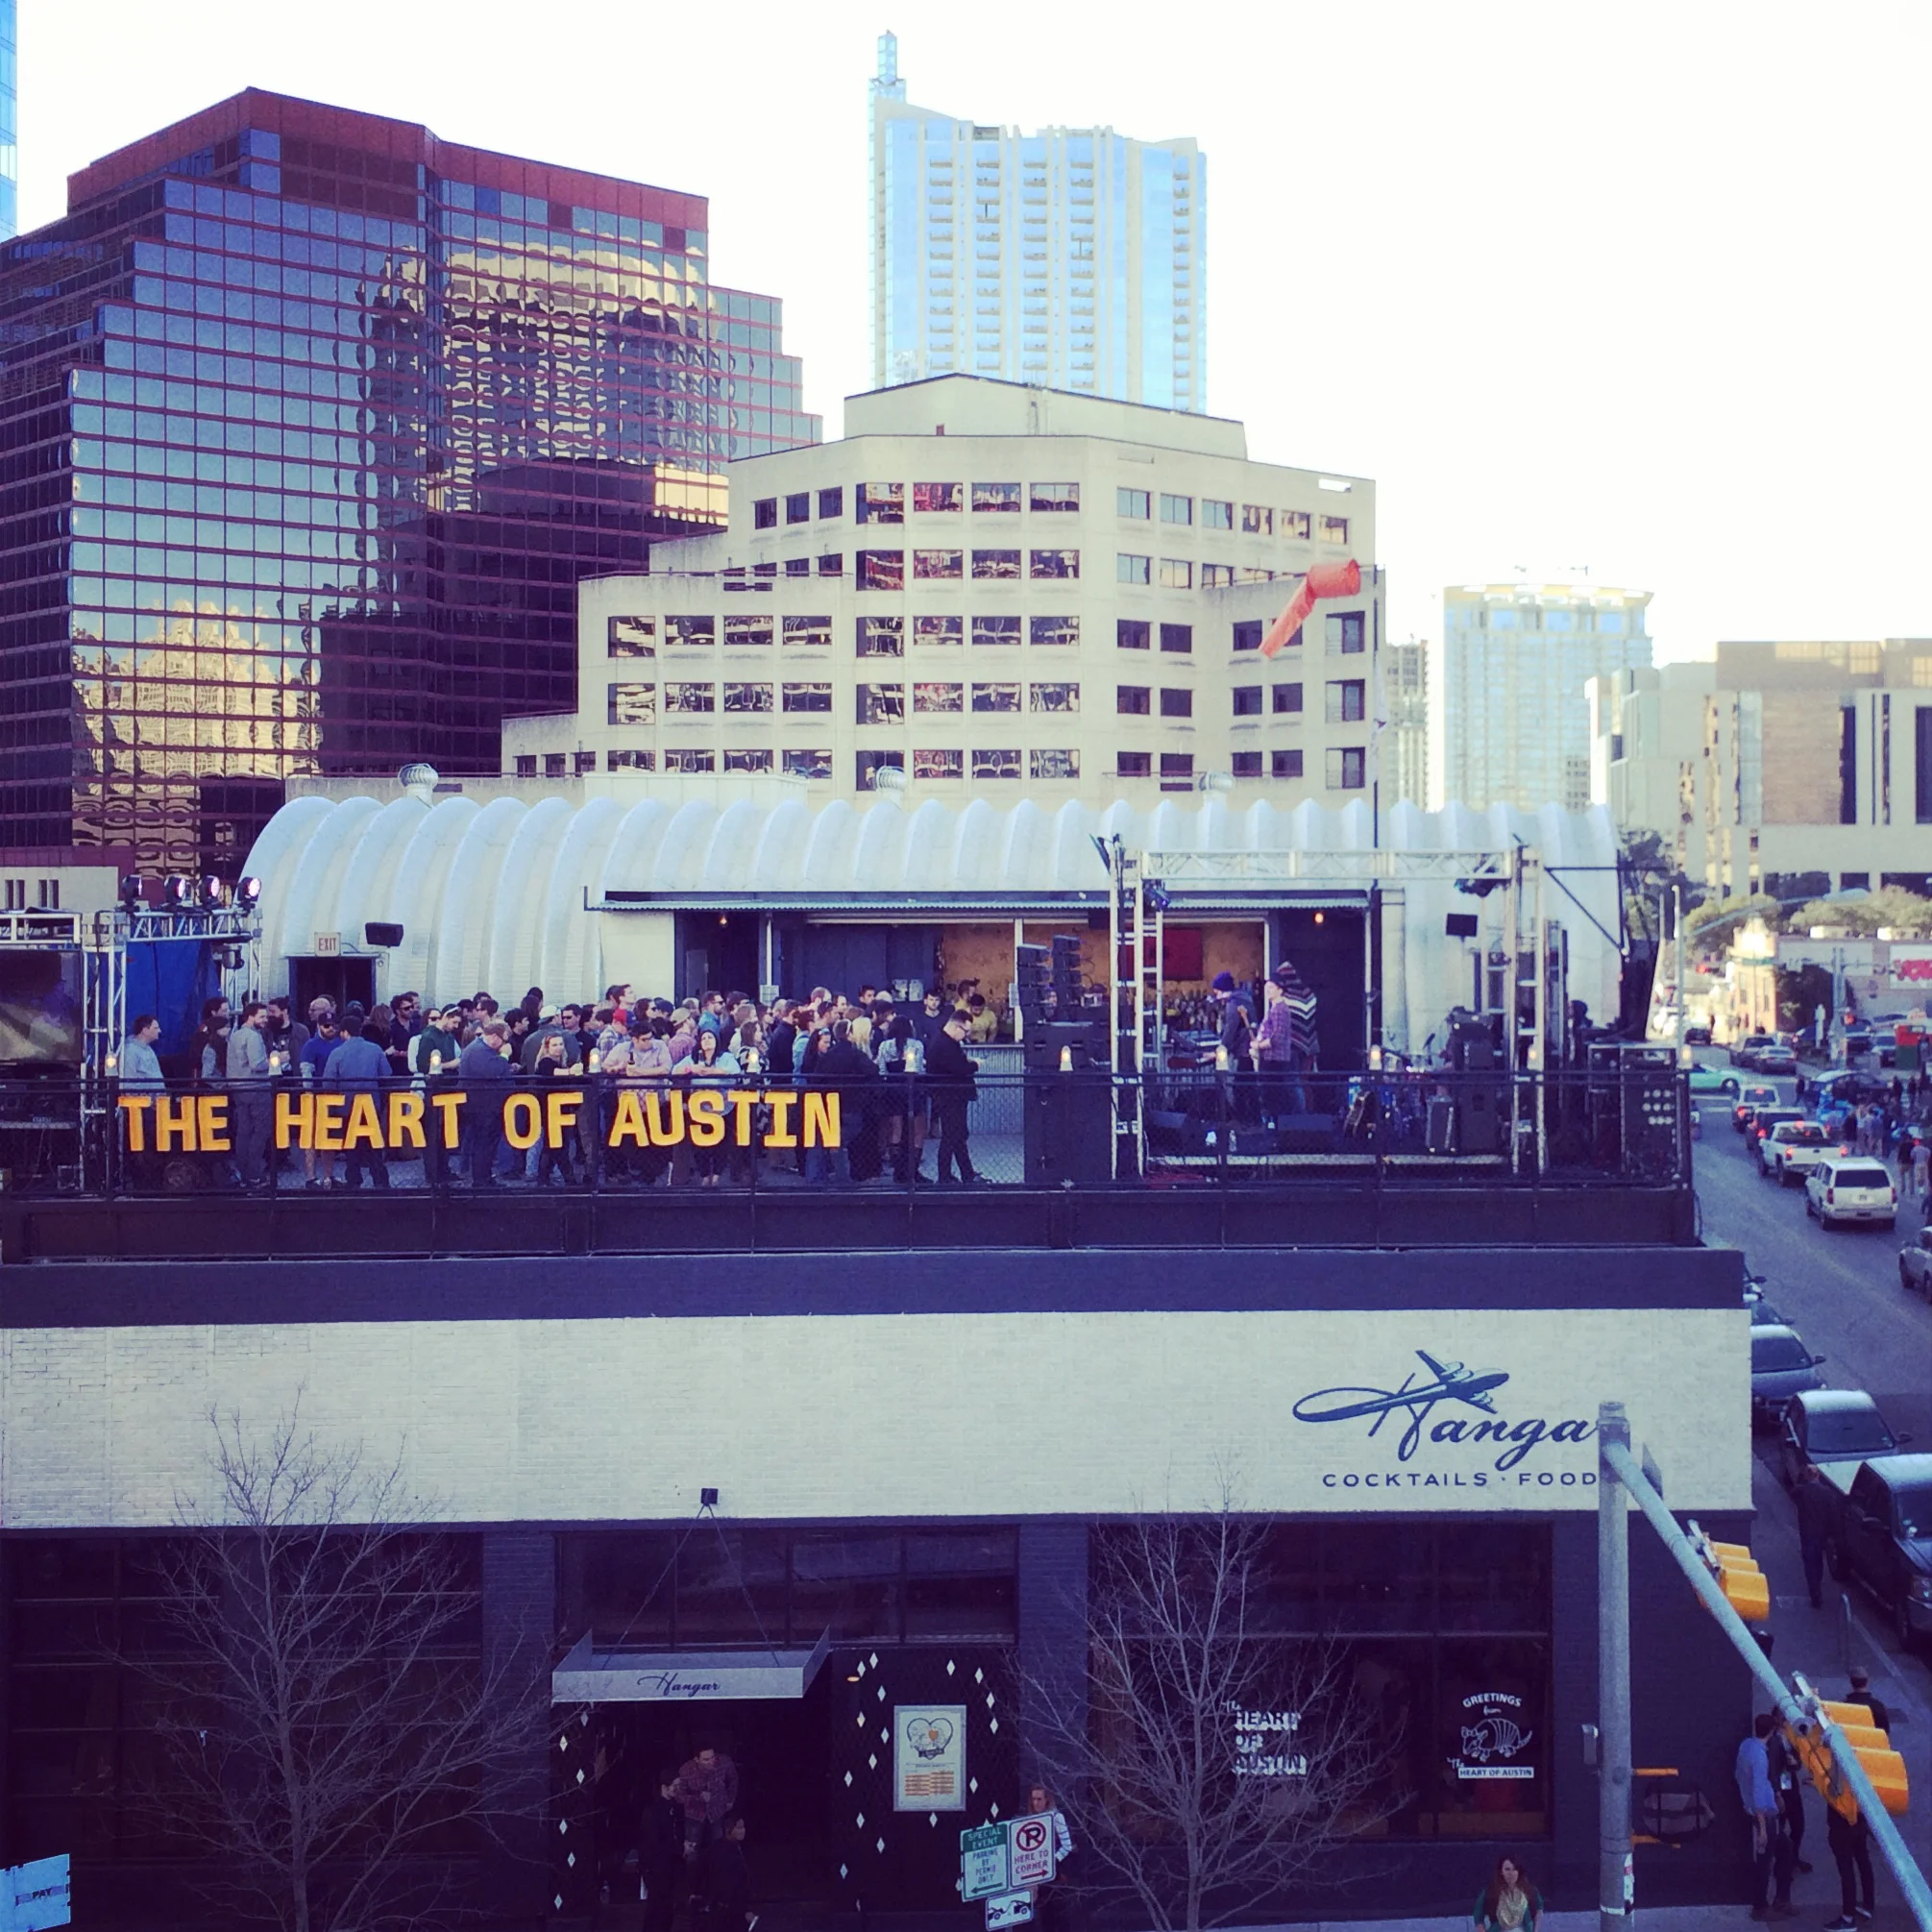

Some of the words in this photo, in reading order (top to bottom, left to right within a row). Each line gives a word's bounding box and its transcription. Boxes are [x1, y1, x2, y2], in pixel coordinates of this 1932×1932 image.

[318, 937, 337, 951] EXIT
[118, 1094, 231, 1152] THE
[275, 1092, 467, 1149] HEART
[503, 1092, 583, 1149] OF
[608, 1089, 842, 1148] AUSTIN
[1292, 1353, 1599, 1472] Hanga
[1322, 1472, 1488, 1487] COCKTAILS
[1518, 1471, 1597, 1486] FOOD
[636, 1672, 721, 1698] Hangar
[1462, 1693, 1522, 1707] GREETINGS
[1234, 1710, 1302, 1731] HEART
[1235, 1733, 1263, 1753] OF
[1232, 1754, 1307, 1776] AUSTIN
[967, 1827, 1002, 1841] SPECIAL
[972, 1836, 998, 1849] EVENT
[1015, 1852, 1035, 1864] HERE
[1039, 1849, 1049, 1858] TO
[1015, 1859, 1048, 1874] CORNER
